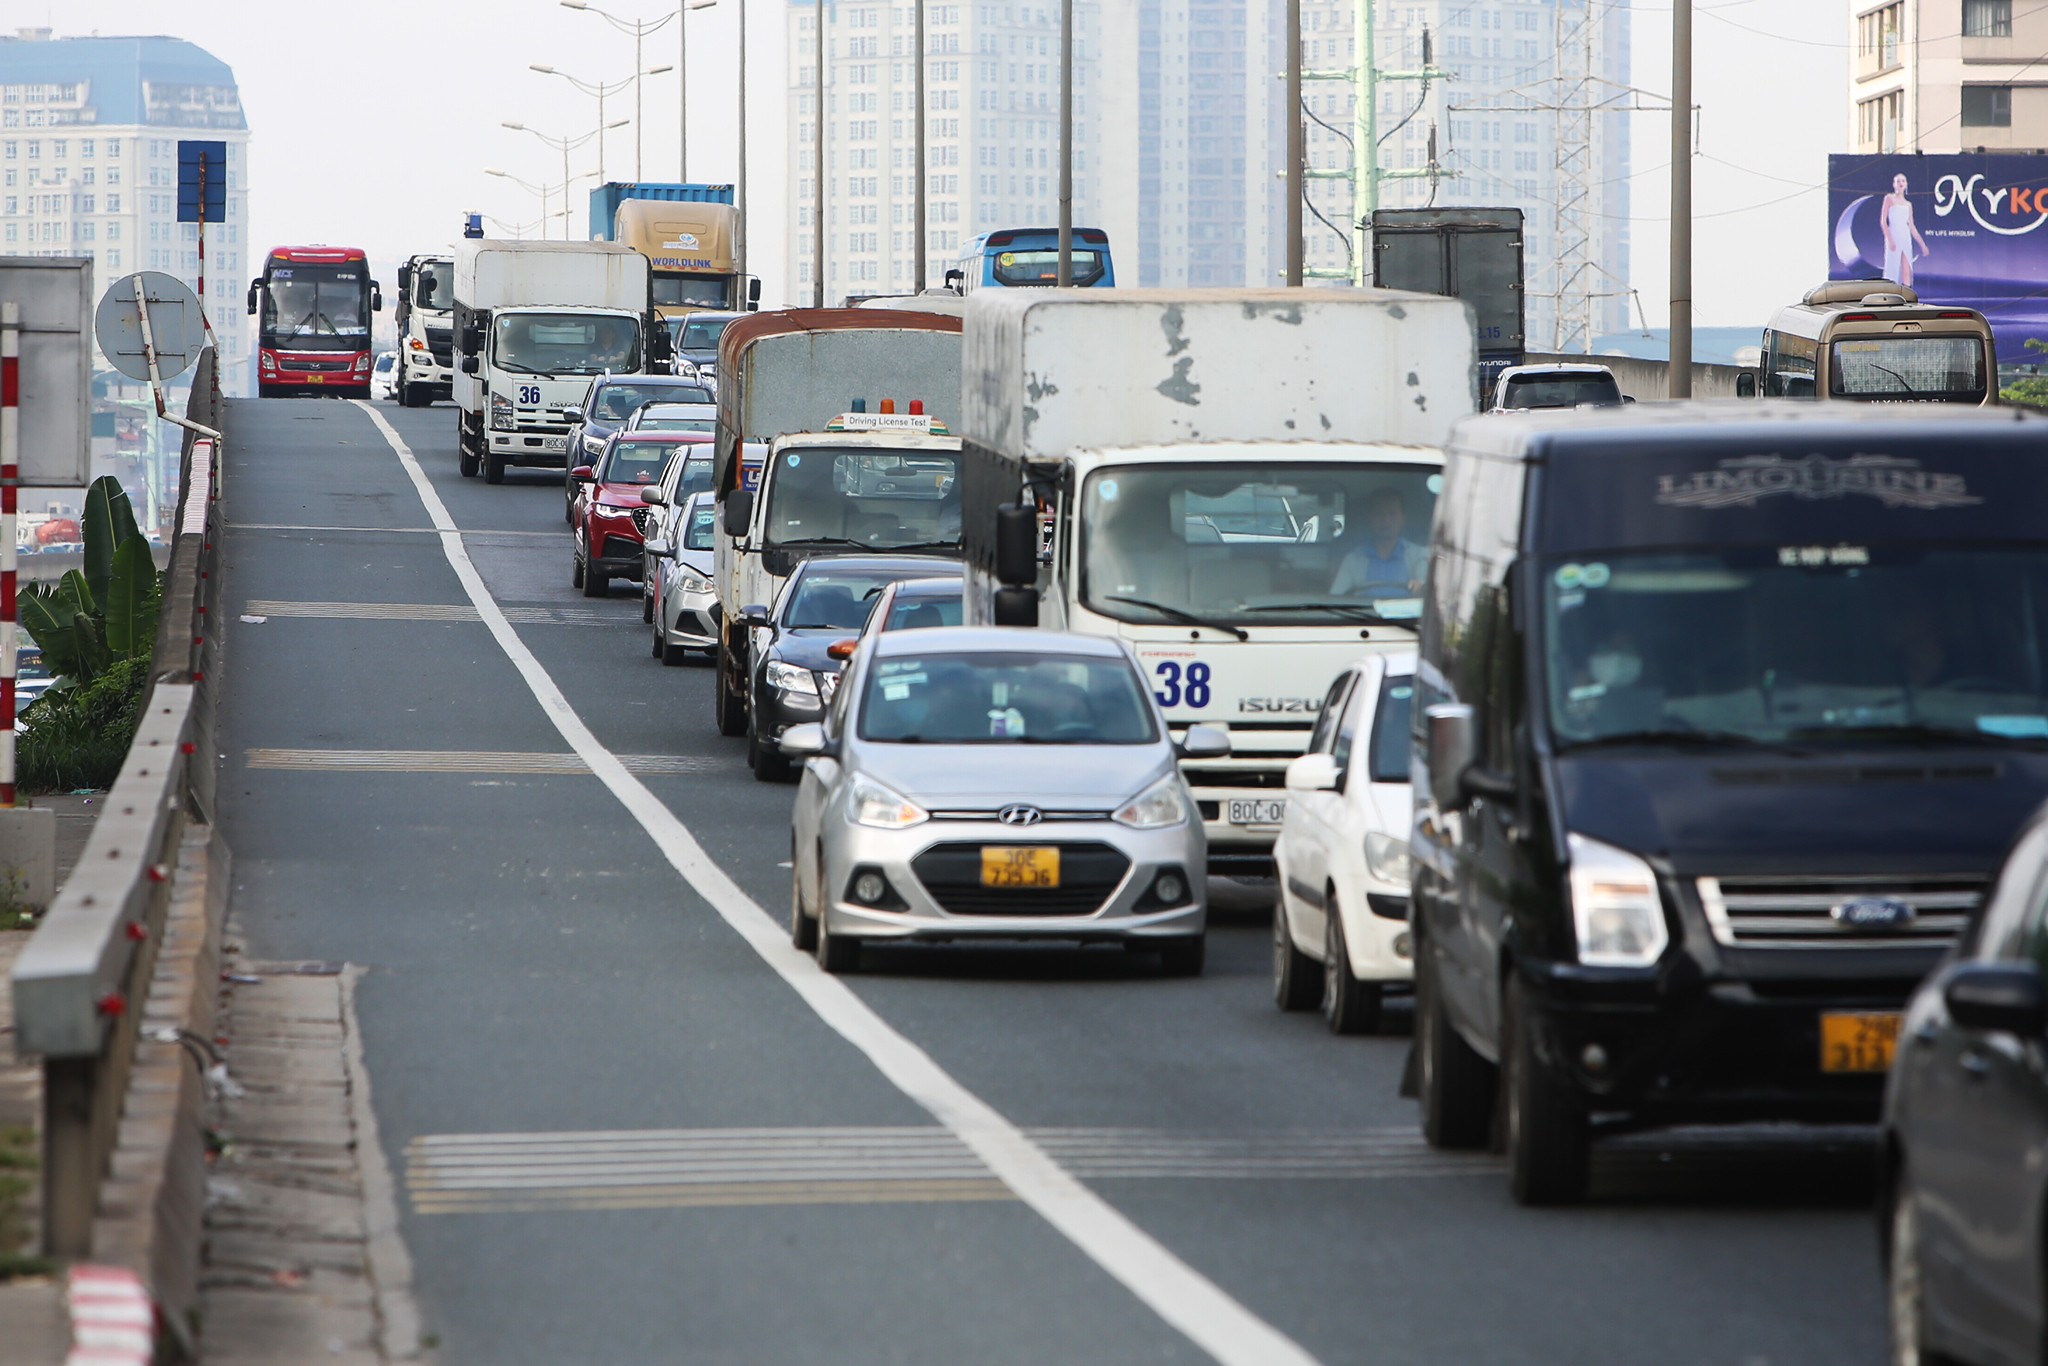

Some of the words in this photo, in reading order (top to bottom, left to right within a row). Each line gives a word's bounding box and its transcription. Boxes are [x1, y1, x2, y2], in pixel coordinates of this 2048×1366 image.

[652, 257, 712, 268] WORLDLINK
[519, 386, 540, 404] 36
[849, 416, 877, 427] Driving
[879, 417, 908, 426] License
[911, 418, 926, 426] Test
[1656, 463, 1967, 498] LIMOUSINE
[1155, 661, 1210, 708] 38
[1238, 698, 1321, 713] ISUZU
